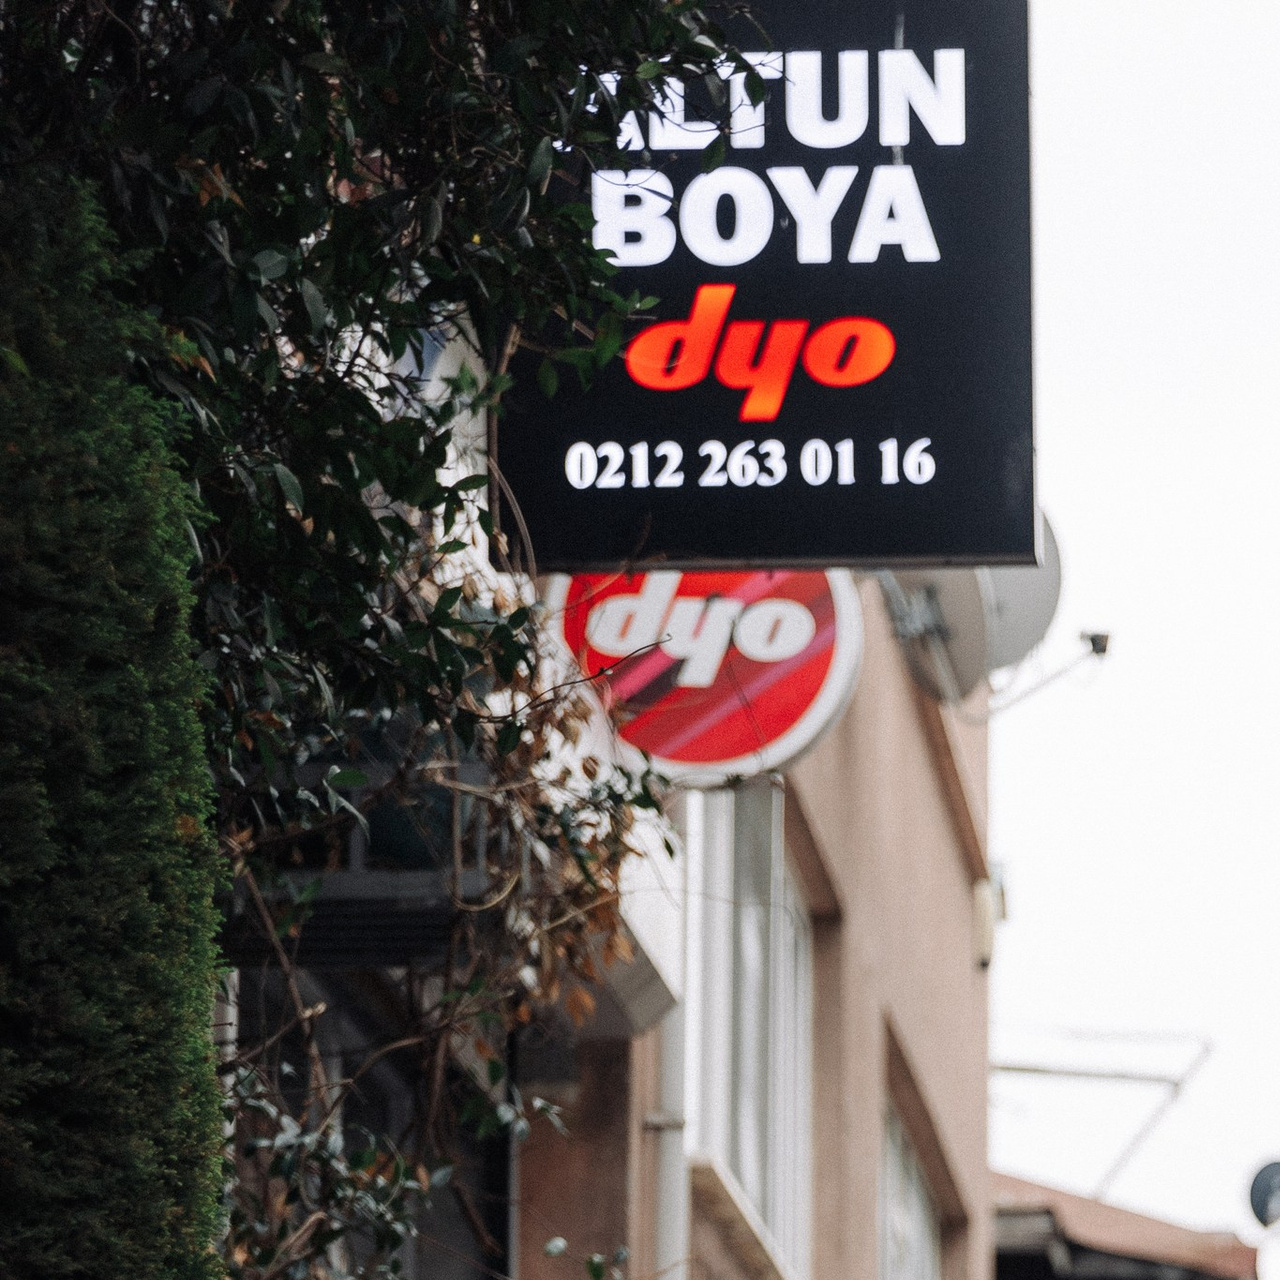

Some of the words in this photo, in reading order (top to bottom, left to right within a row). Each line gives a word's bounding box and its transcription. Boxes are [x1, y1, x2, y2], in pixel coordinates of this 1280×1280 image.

[591, 164, 941, 267] BOYA
[624, 283, 897, 423] dyo
[565, 440, 685, 490] 0212
[698, 438, 788, 487] 263
[800, 438, 856, 486] 01
[878, 437, 936, 486] 16
[585, 570, 817, 688] dyo
